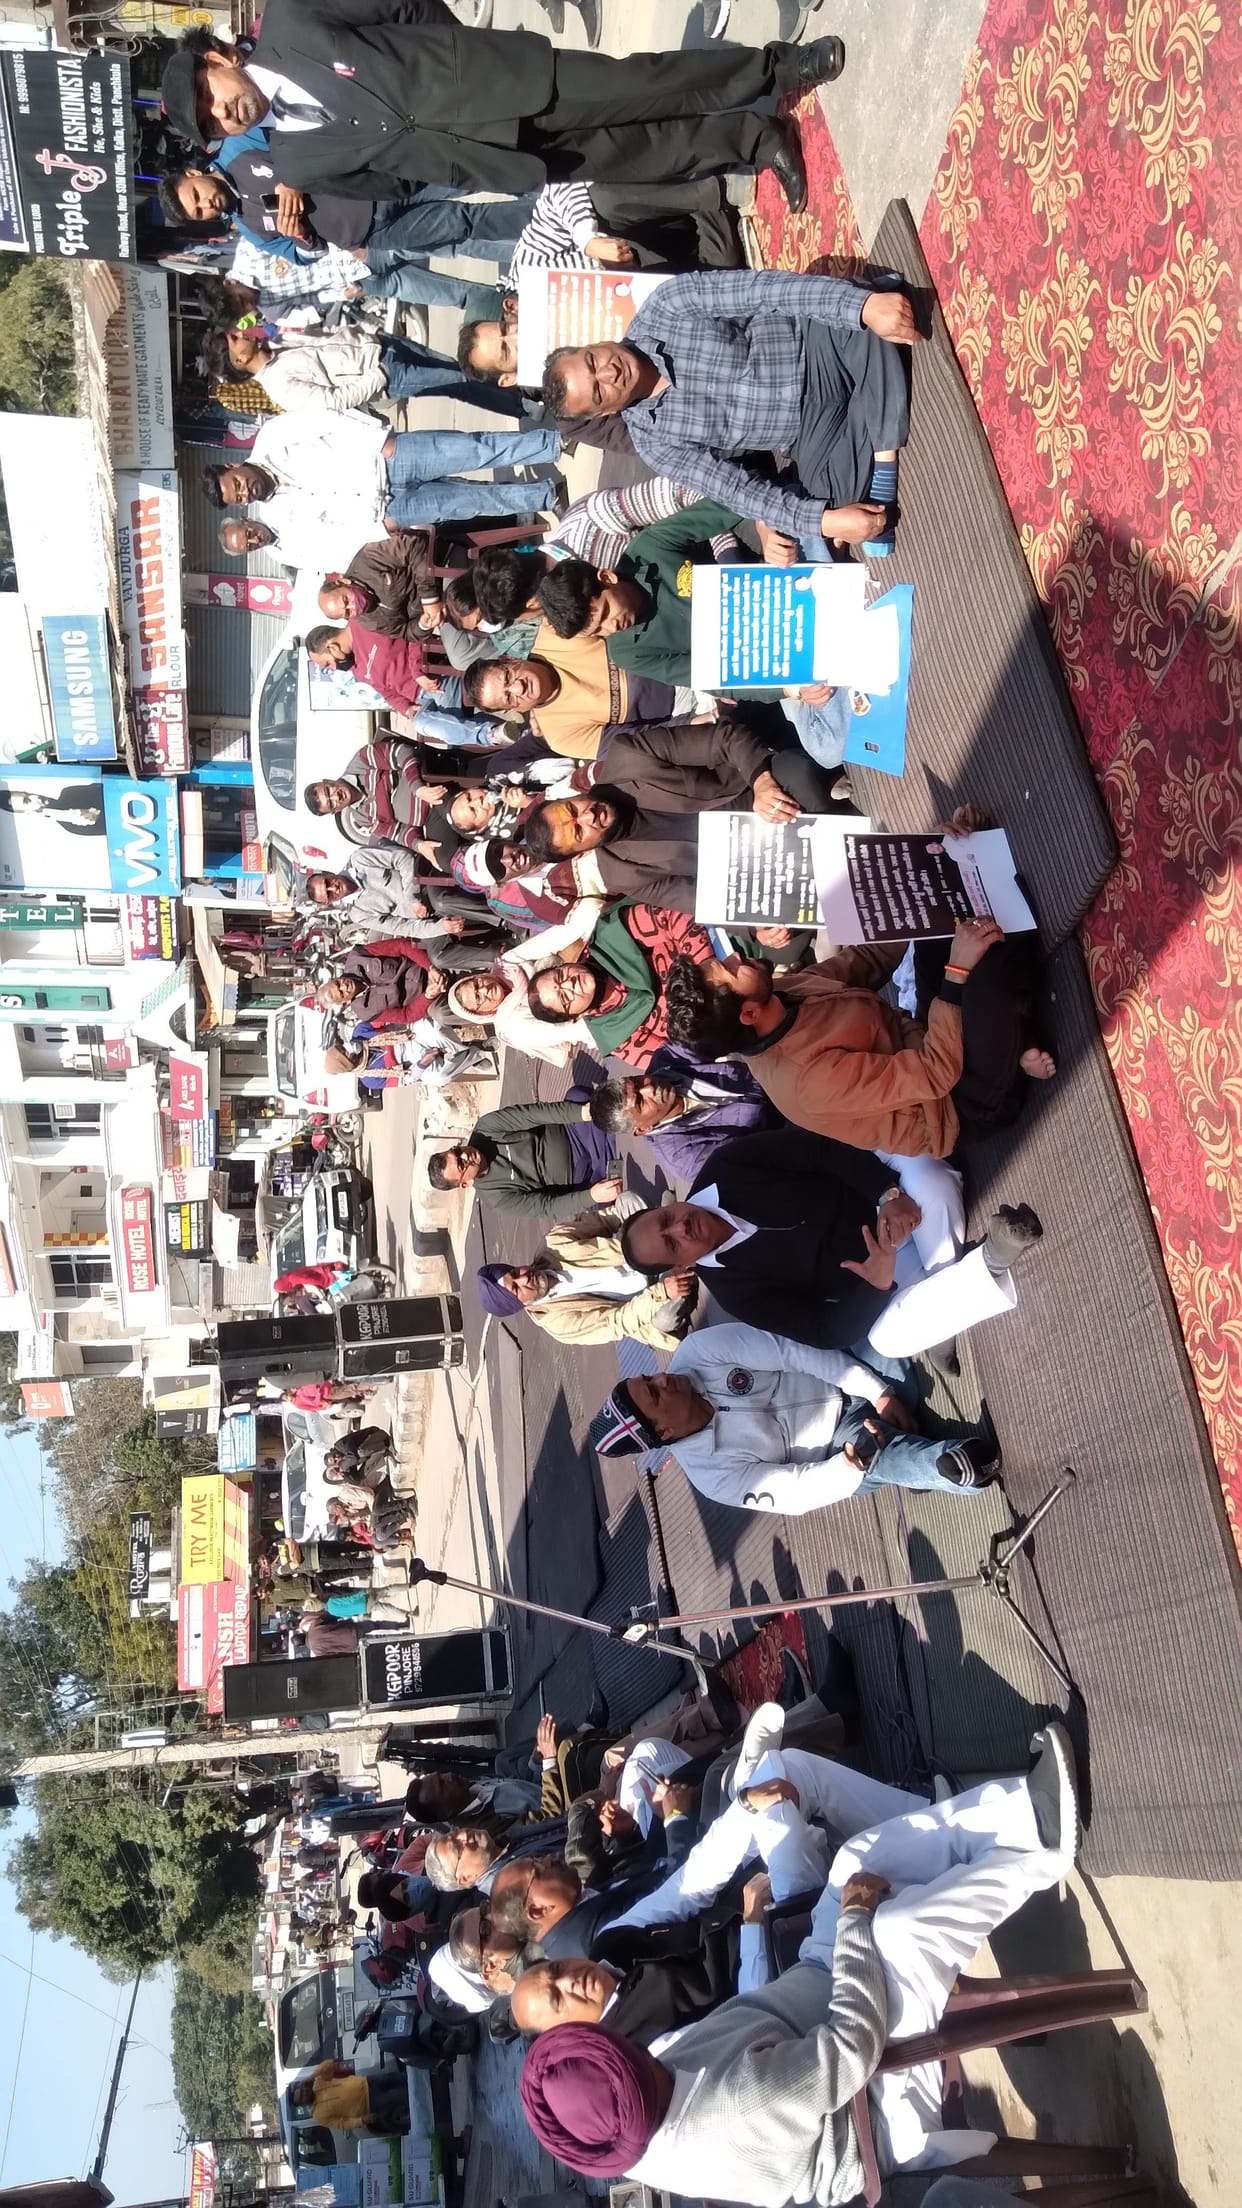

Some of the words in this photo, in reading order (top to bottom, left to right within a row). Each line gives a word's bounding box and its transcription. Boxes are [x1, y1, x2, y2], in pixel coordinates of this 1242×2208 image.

[12, 53, 29, 102] 9996079815
[90, 82, 102, 104] Kids
[110, 64, 122, 104] Panchkula
[57, 58, 88, 152] FASHIONISTA
[92, 106, 102, 115] &
[92, 116, 104, 136] She
[94, 138, 106, 154] He,
[115, 176, 126, 194] SDM
[31, 204, 42, 219] LORD
[116, 194, 128, 211] Near
[33, 220, 42, 232] THE
[56, 190, 90, 255] Triple
[34, 232, 44, 253] PRAISE
[118, 232, 131, 258] Railway
[132, 312, 148, 361] GARMENTS
[110, 374, 134, 455] BHARAT
[138, 418, 150, 426] OF
[138, 428, 152, 458] HOUSE
[118, 526, 130, 574] DURGA
[130, 496, 168, 671] SANSAR
[60, 630, 100, 746] SAMSUNG
[144, 722, 160, 744] The
[163, 723, 185, 771] Famous
[244, 812, 256, 842] PHOTO
[160, 914, 172, 959] GARMENTS
[124, 1200, 134, 1220] ROSE
[136, 1198, 147, 1220] HOTEL
[127, 1225, 146, 1260] HOTEL
[132, 1262, 150, 1290] ROSE
[356, 1304, 372, 1340] KAPOOR
[370, 1304, 381, 1335] PINJORE
[190, 1493, 207, 1524] ME
[742, 1492, 774, 1507] 3
[190, 1534, 208, 1568] TRY
[234, 1620, 247, 1660] LAPTOP
[384, 1642, 402, 1701] KAPOOR
[402, 1646, 413, 1693] PINJORE
